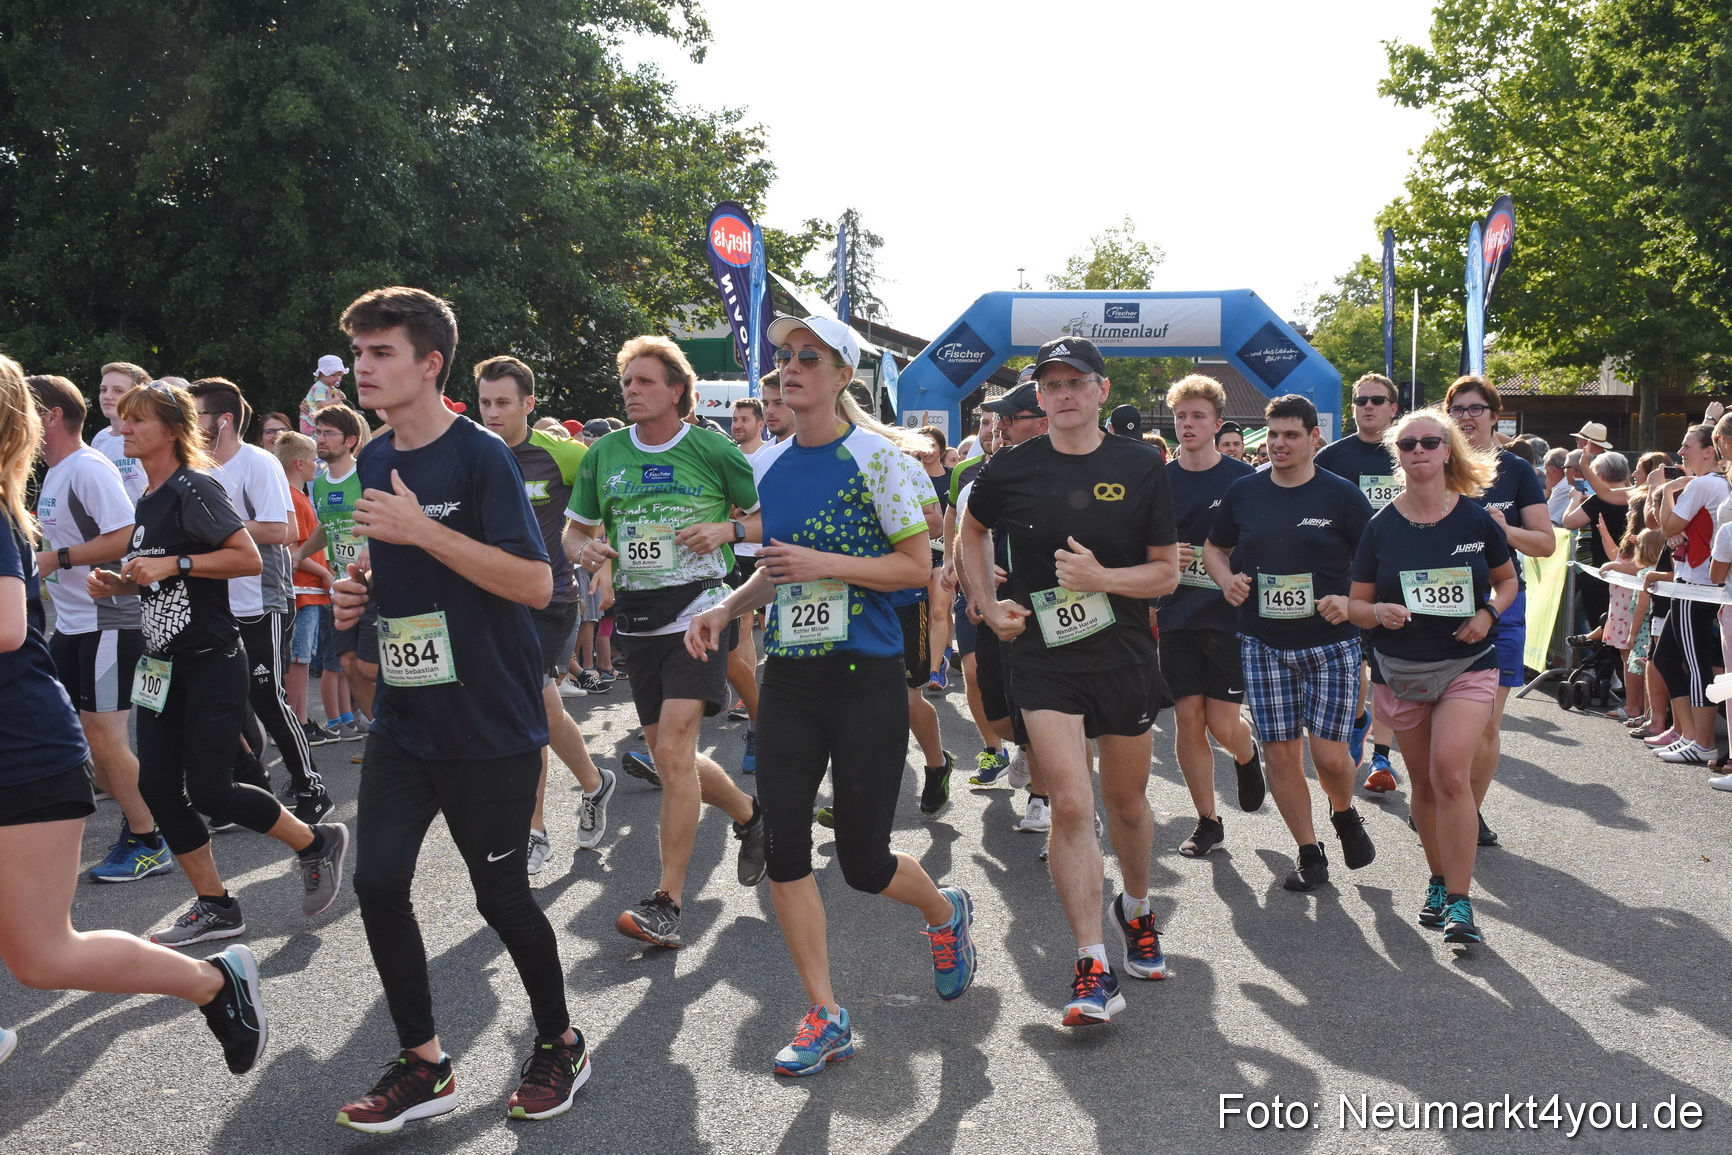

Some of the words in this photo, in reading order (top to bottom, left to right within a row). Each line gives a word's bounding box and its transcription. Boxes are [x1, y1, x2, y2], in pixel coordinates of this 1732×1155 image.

[1091, 323, 1170, 338] firmenlauf
[944, 349, 986, 359] Fischer
[1048, 350, 1071, 358] adidas
[624, 480, 705, 497] firmenlauf
[652, 503, 693, 513] Firmen
[1297, 518, 1322, 526] JURA
[335, 544, 355, 557] 570
[628, 541, 661, 560] 565
[1451, 542, 1478, 555] JURA
[1182, 560, 1206, 576] 43
[1263, 590, 1306, 606] 1463
[1412, 585, 1464, 604] 1388
[791, 602, 830, 628] 226
[1056, 602, 1086, 627] 80
[1055, 625, 1079, 635] Wendlik
[1078, 617, 1098, 628] Harald
[424, 631, 442, 640] 2019
[382, 639, 440, 668] 1384
[405, 666, 440, 675] Sebastian
[141, 673, 162, 696] 100
[258, 676, 269, 684] 94
